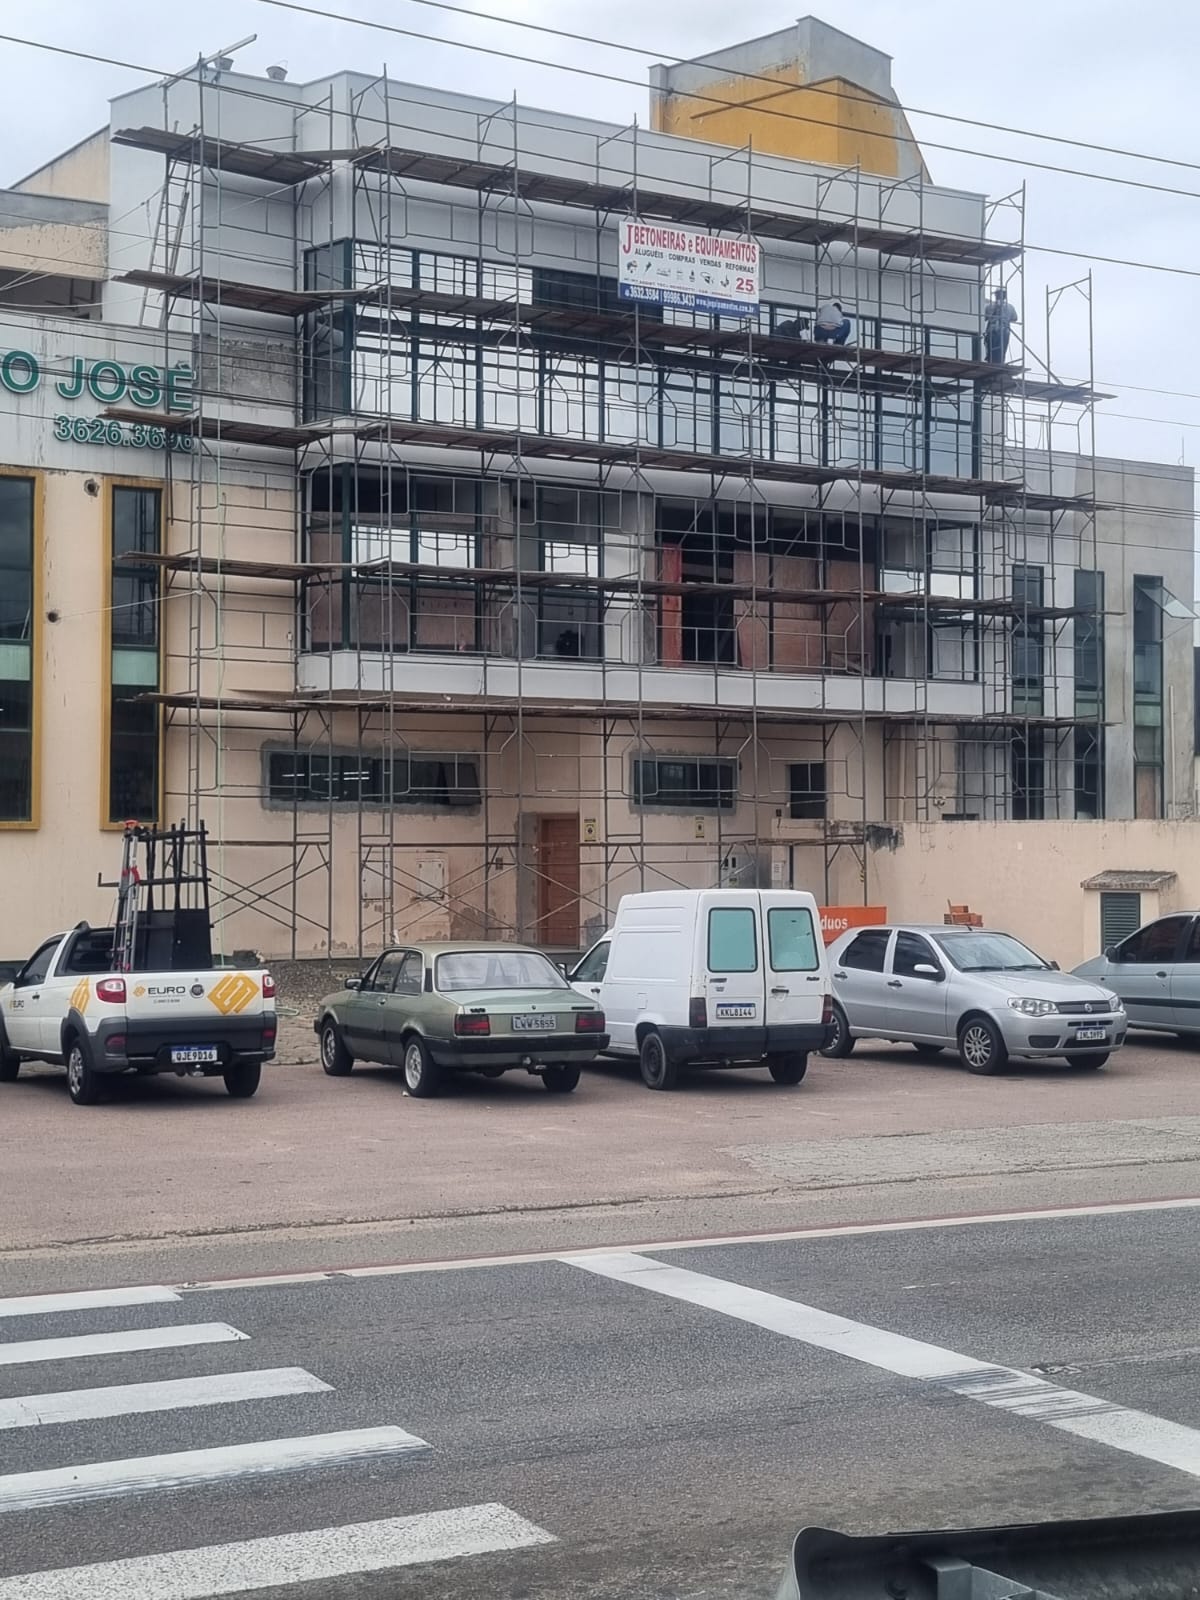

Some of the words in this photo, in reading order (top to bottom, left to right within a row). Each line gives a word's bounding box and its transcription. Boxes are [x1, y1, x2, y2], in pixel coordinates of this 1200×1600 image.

[634, 226, 686, 252] BETONEIRAS
[688, 240, 693, 252] e
[695, 236, 757, 263] EQUIPAMENTOS
[668, 253, 696, 264] COMPRAS
[700, 258, 722, 268] VENDAS
[725, 262, 754, 273] REFORMAS
[735, 277, 754, 292] 25
[56, 356, 196, 411] JOSÉ
[148, 986, 186, 995] EURO
